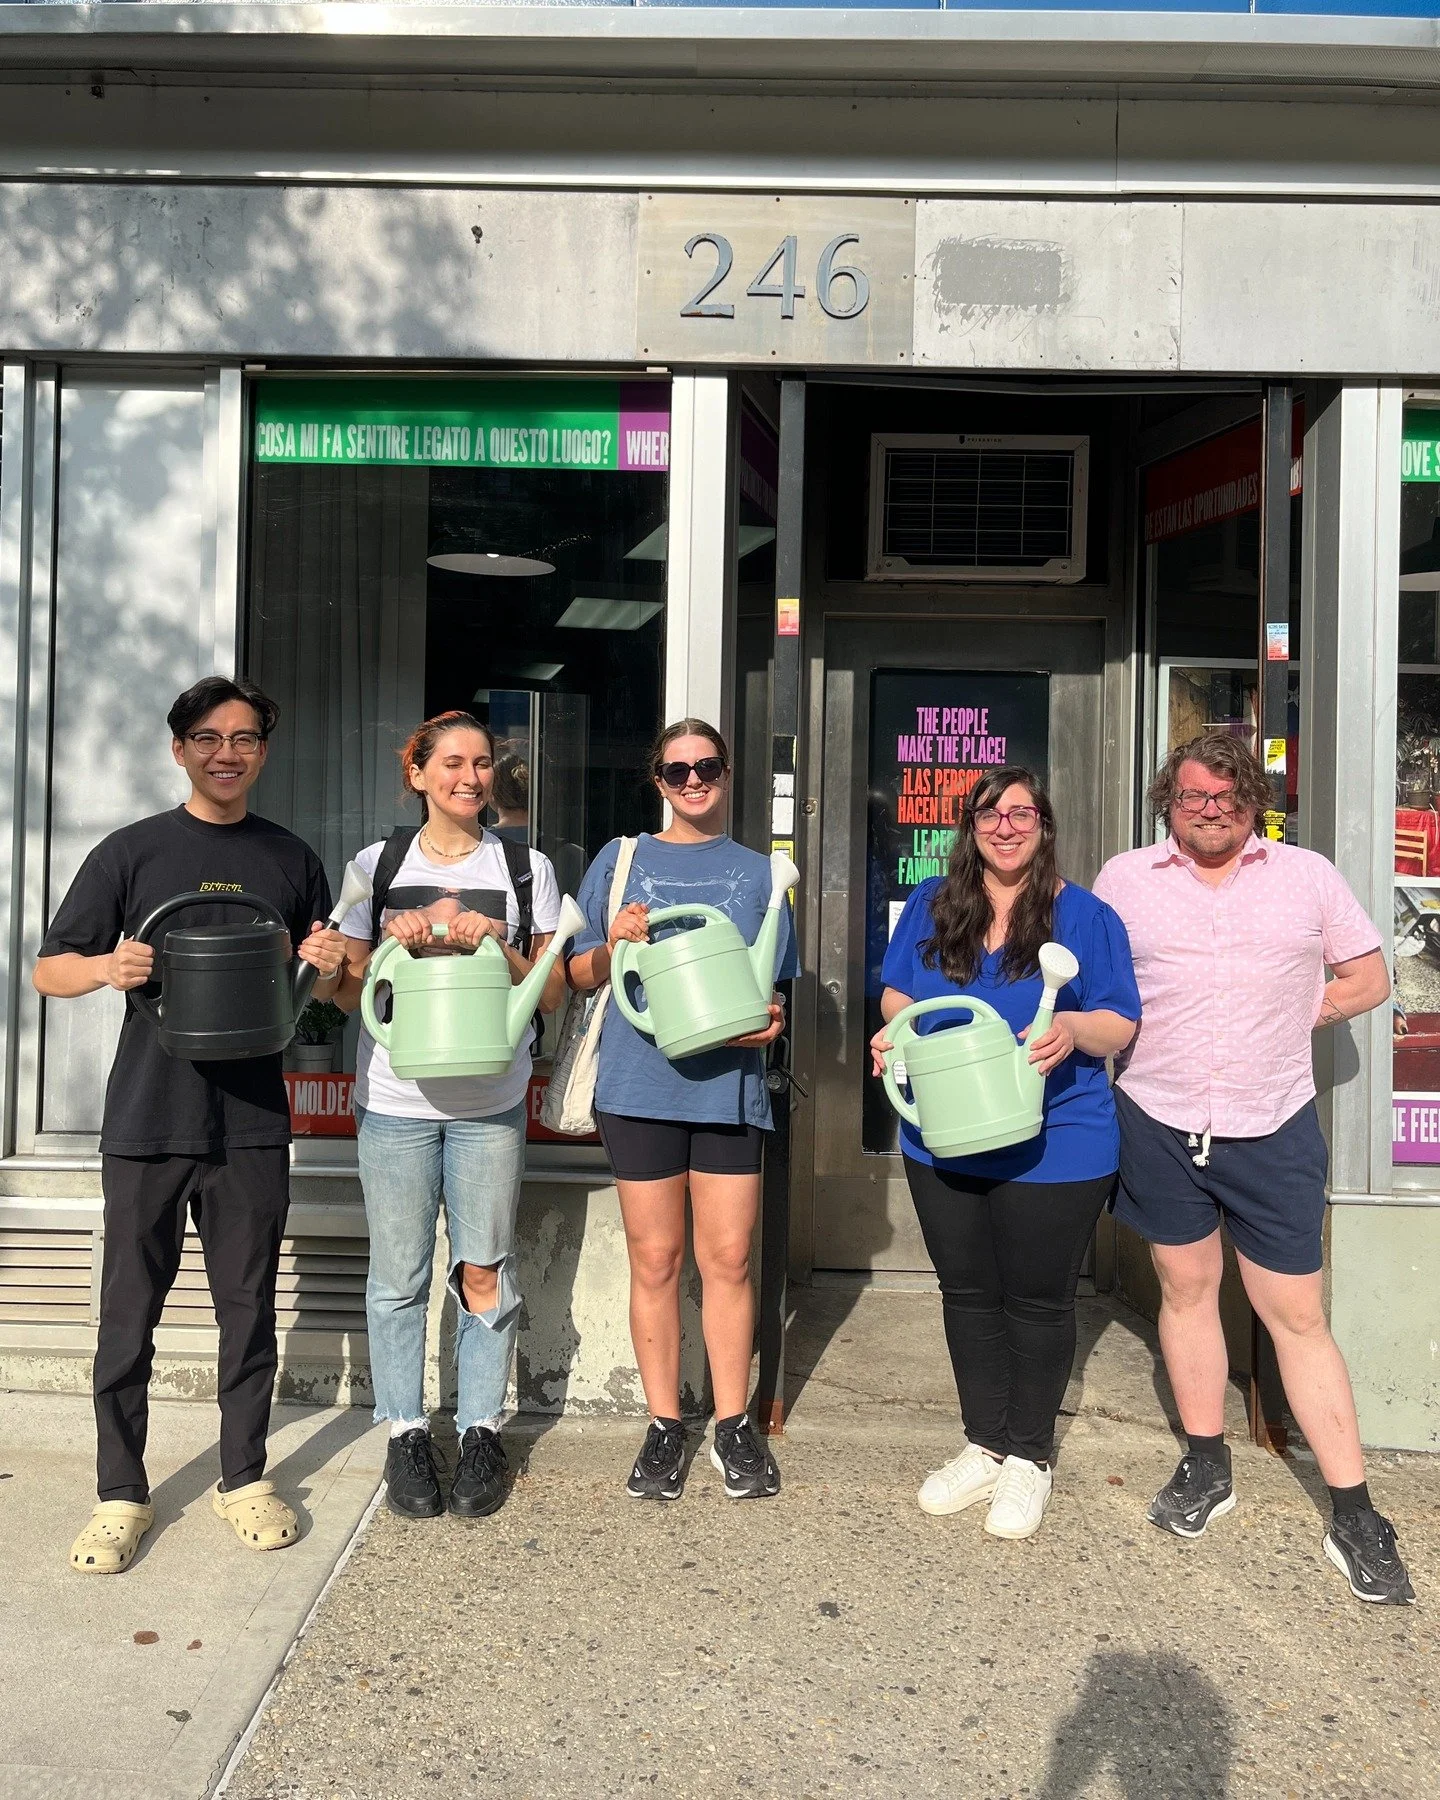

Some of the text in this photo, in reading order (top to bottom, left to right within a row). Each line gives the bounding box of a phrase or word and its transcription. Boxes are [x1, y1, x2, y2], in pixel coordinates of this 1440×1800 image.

[680, 232, 870, 319] 246
[256, 422, 611, 465] COSA MI FA SENTIRE LEGATO A QUESTO LUOGO?
[916, 707, 988, 735] THE PEOPLE
[898, 735, 1006, 764] MAKE THE PLACE!
[934, 768, 987, 796] PERSON
[898, 796, 938, 824] HACEN
[941, 797, 955, 824] EL
[913, 829, 928, 857] LE
[1392, 1107, 1440, 1142] E FEE
